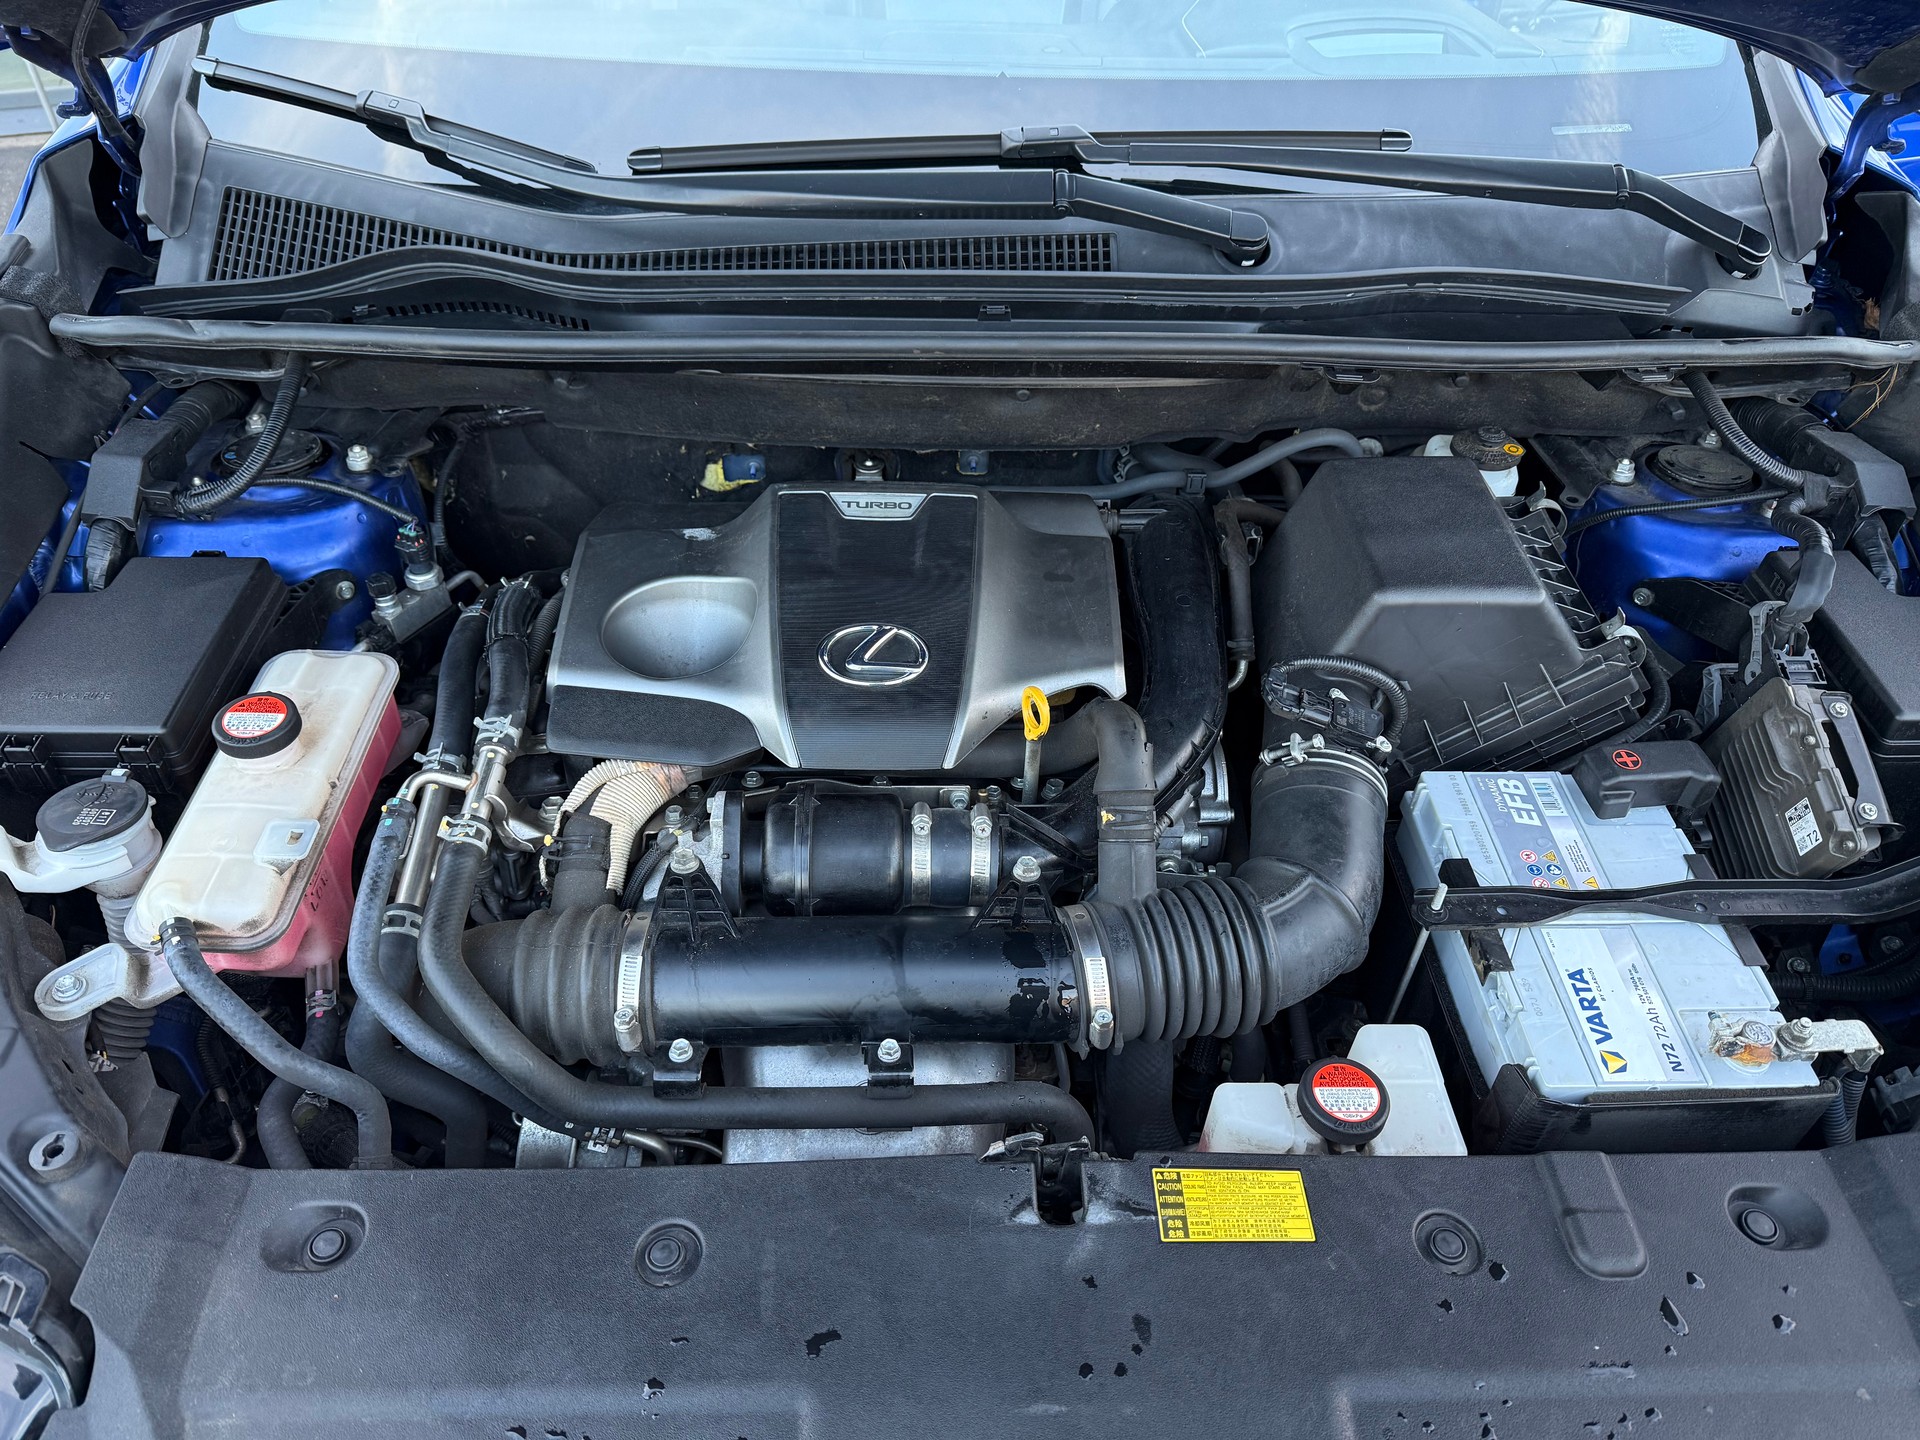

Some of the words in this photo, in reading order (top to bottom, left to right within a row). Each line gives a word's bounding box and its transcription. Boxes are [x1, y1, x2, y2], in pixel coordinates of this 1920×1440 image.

[842, 500, 912, 509] TURBO
[30, 692, 68, 700] RELAY
[82, 692, 114, 700] FUSE
[1486, 778, 1508, 812] DYNAMIC
[1497, 778, 1542, 826] EFB
[1588, 967, 1602, 993] CLARIOS
[1567, 968, 1613, 1045] VARTA
[1646, 1008, 1669, 1040] 72Ah
[1661, 1043, 1685, 1072] N72
[1334, 1120, 1375, 1132] DENSO
[1167, 1220, 1183, 1228] 危险
